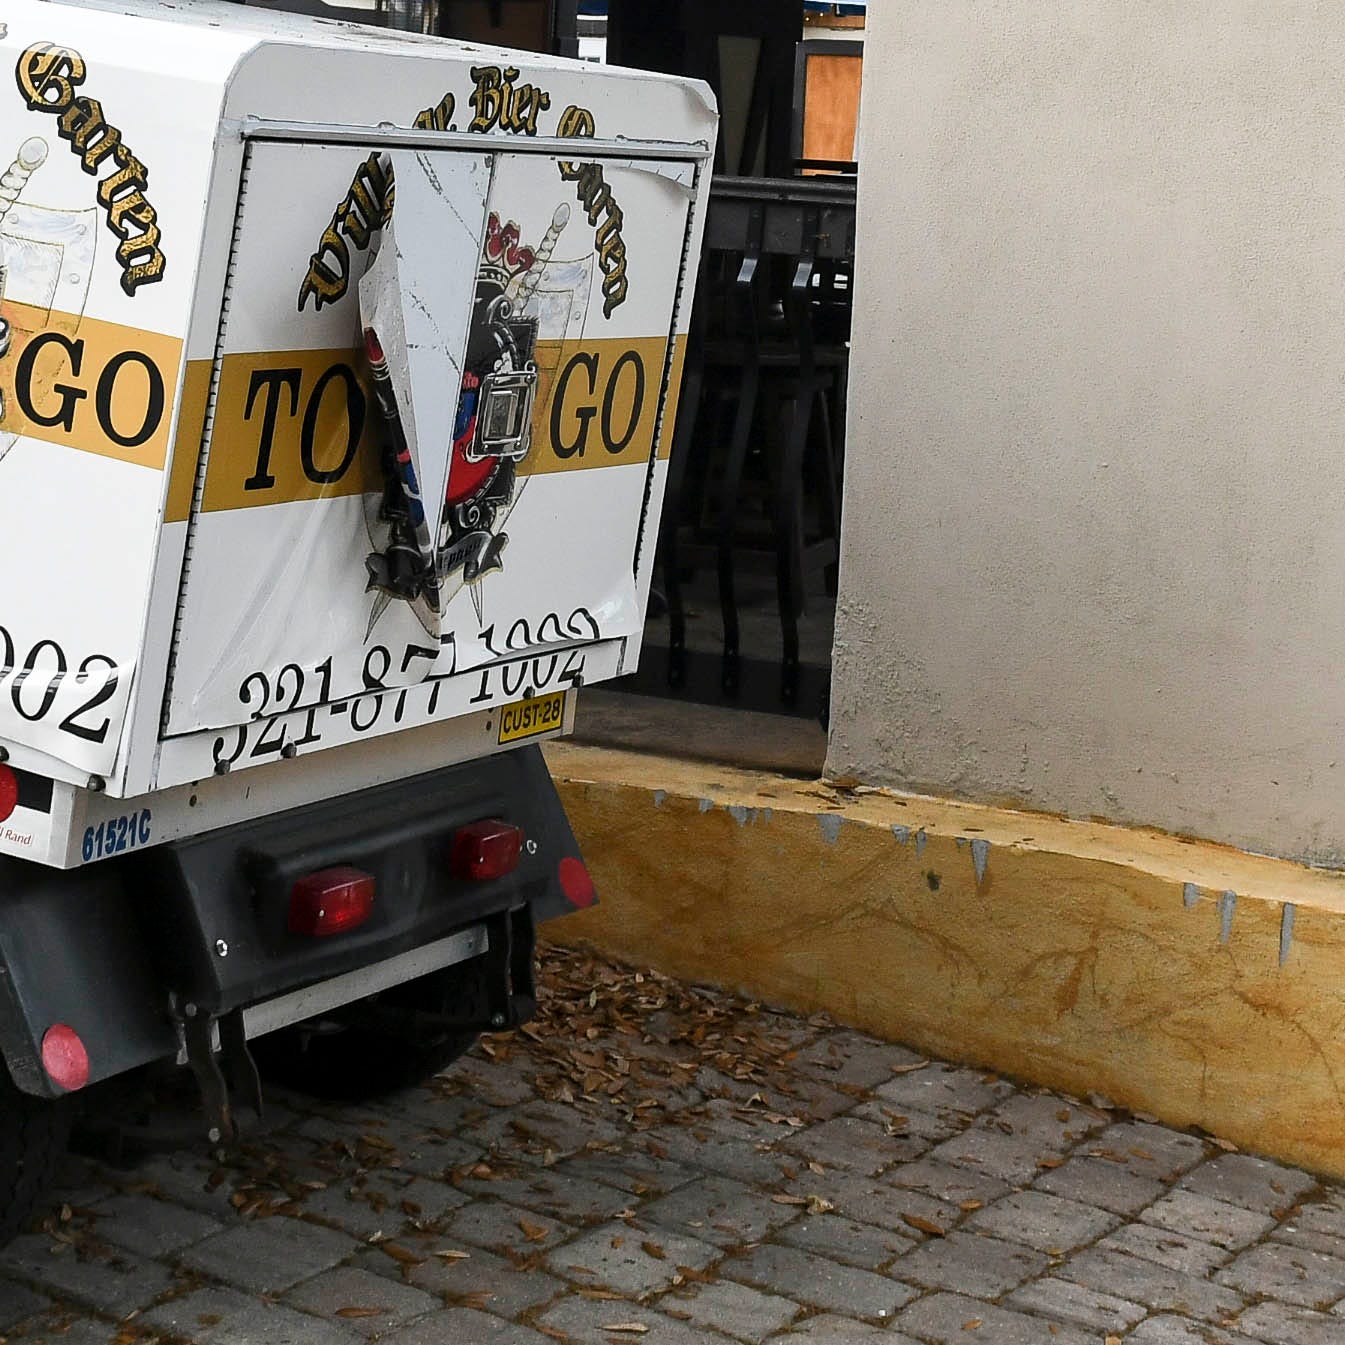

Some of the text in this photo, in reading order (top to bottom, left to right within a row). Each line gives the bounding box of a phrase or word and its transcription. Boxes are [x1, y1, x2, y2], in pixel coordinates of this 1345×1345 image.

[468, 65, 551, 136] Bier
[15, 41, 167, 297] Garten
[15, 331, 166, 447] GO
[243, 349, 645, 491] TO GO
[503, 700, 561, 734] CUST-28
[5, 829, 33, 846] Rand
[81, 808, 152, 862] 61521C
